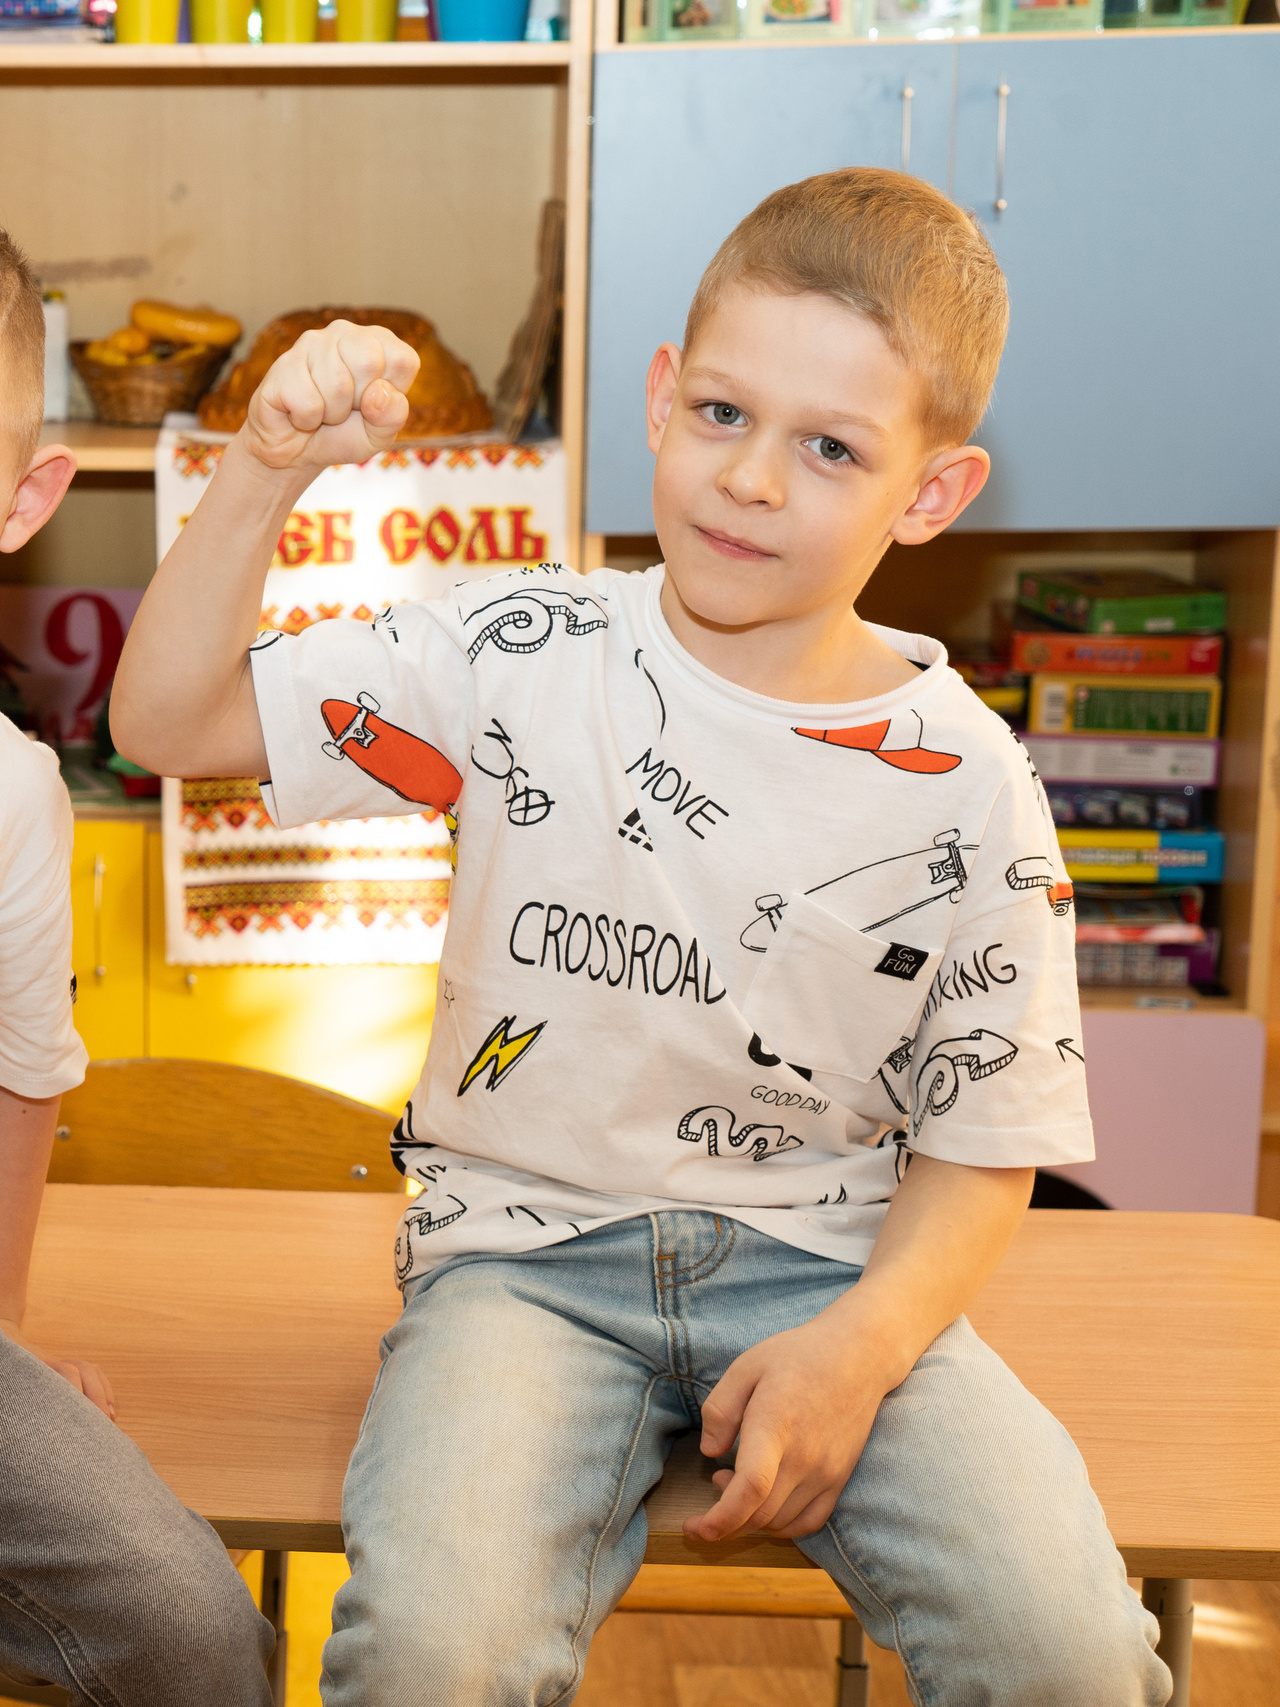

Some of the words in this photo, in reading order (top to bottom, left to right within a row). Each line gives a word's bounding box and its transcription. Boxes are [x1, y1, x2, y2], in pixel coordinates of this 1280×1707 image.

[277, 509, 356, 566] ЕБ
[380, 506, 549, 565] СОЛЬ
[625, 747, 730, 841] MOVE
[883, 958, 917, 974] FUN
